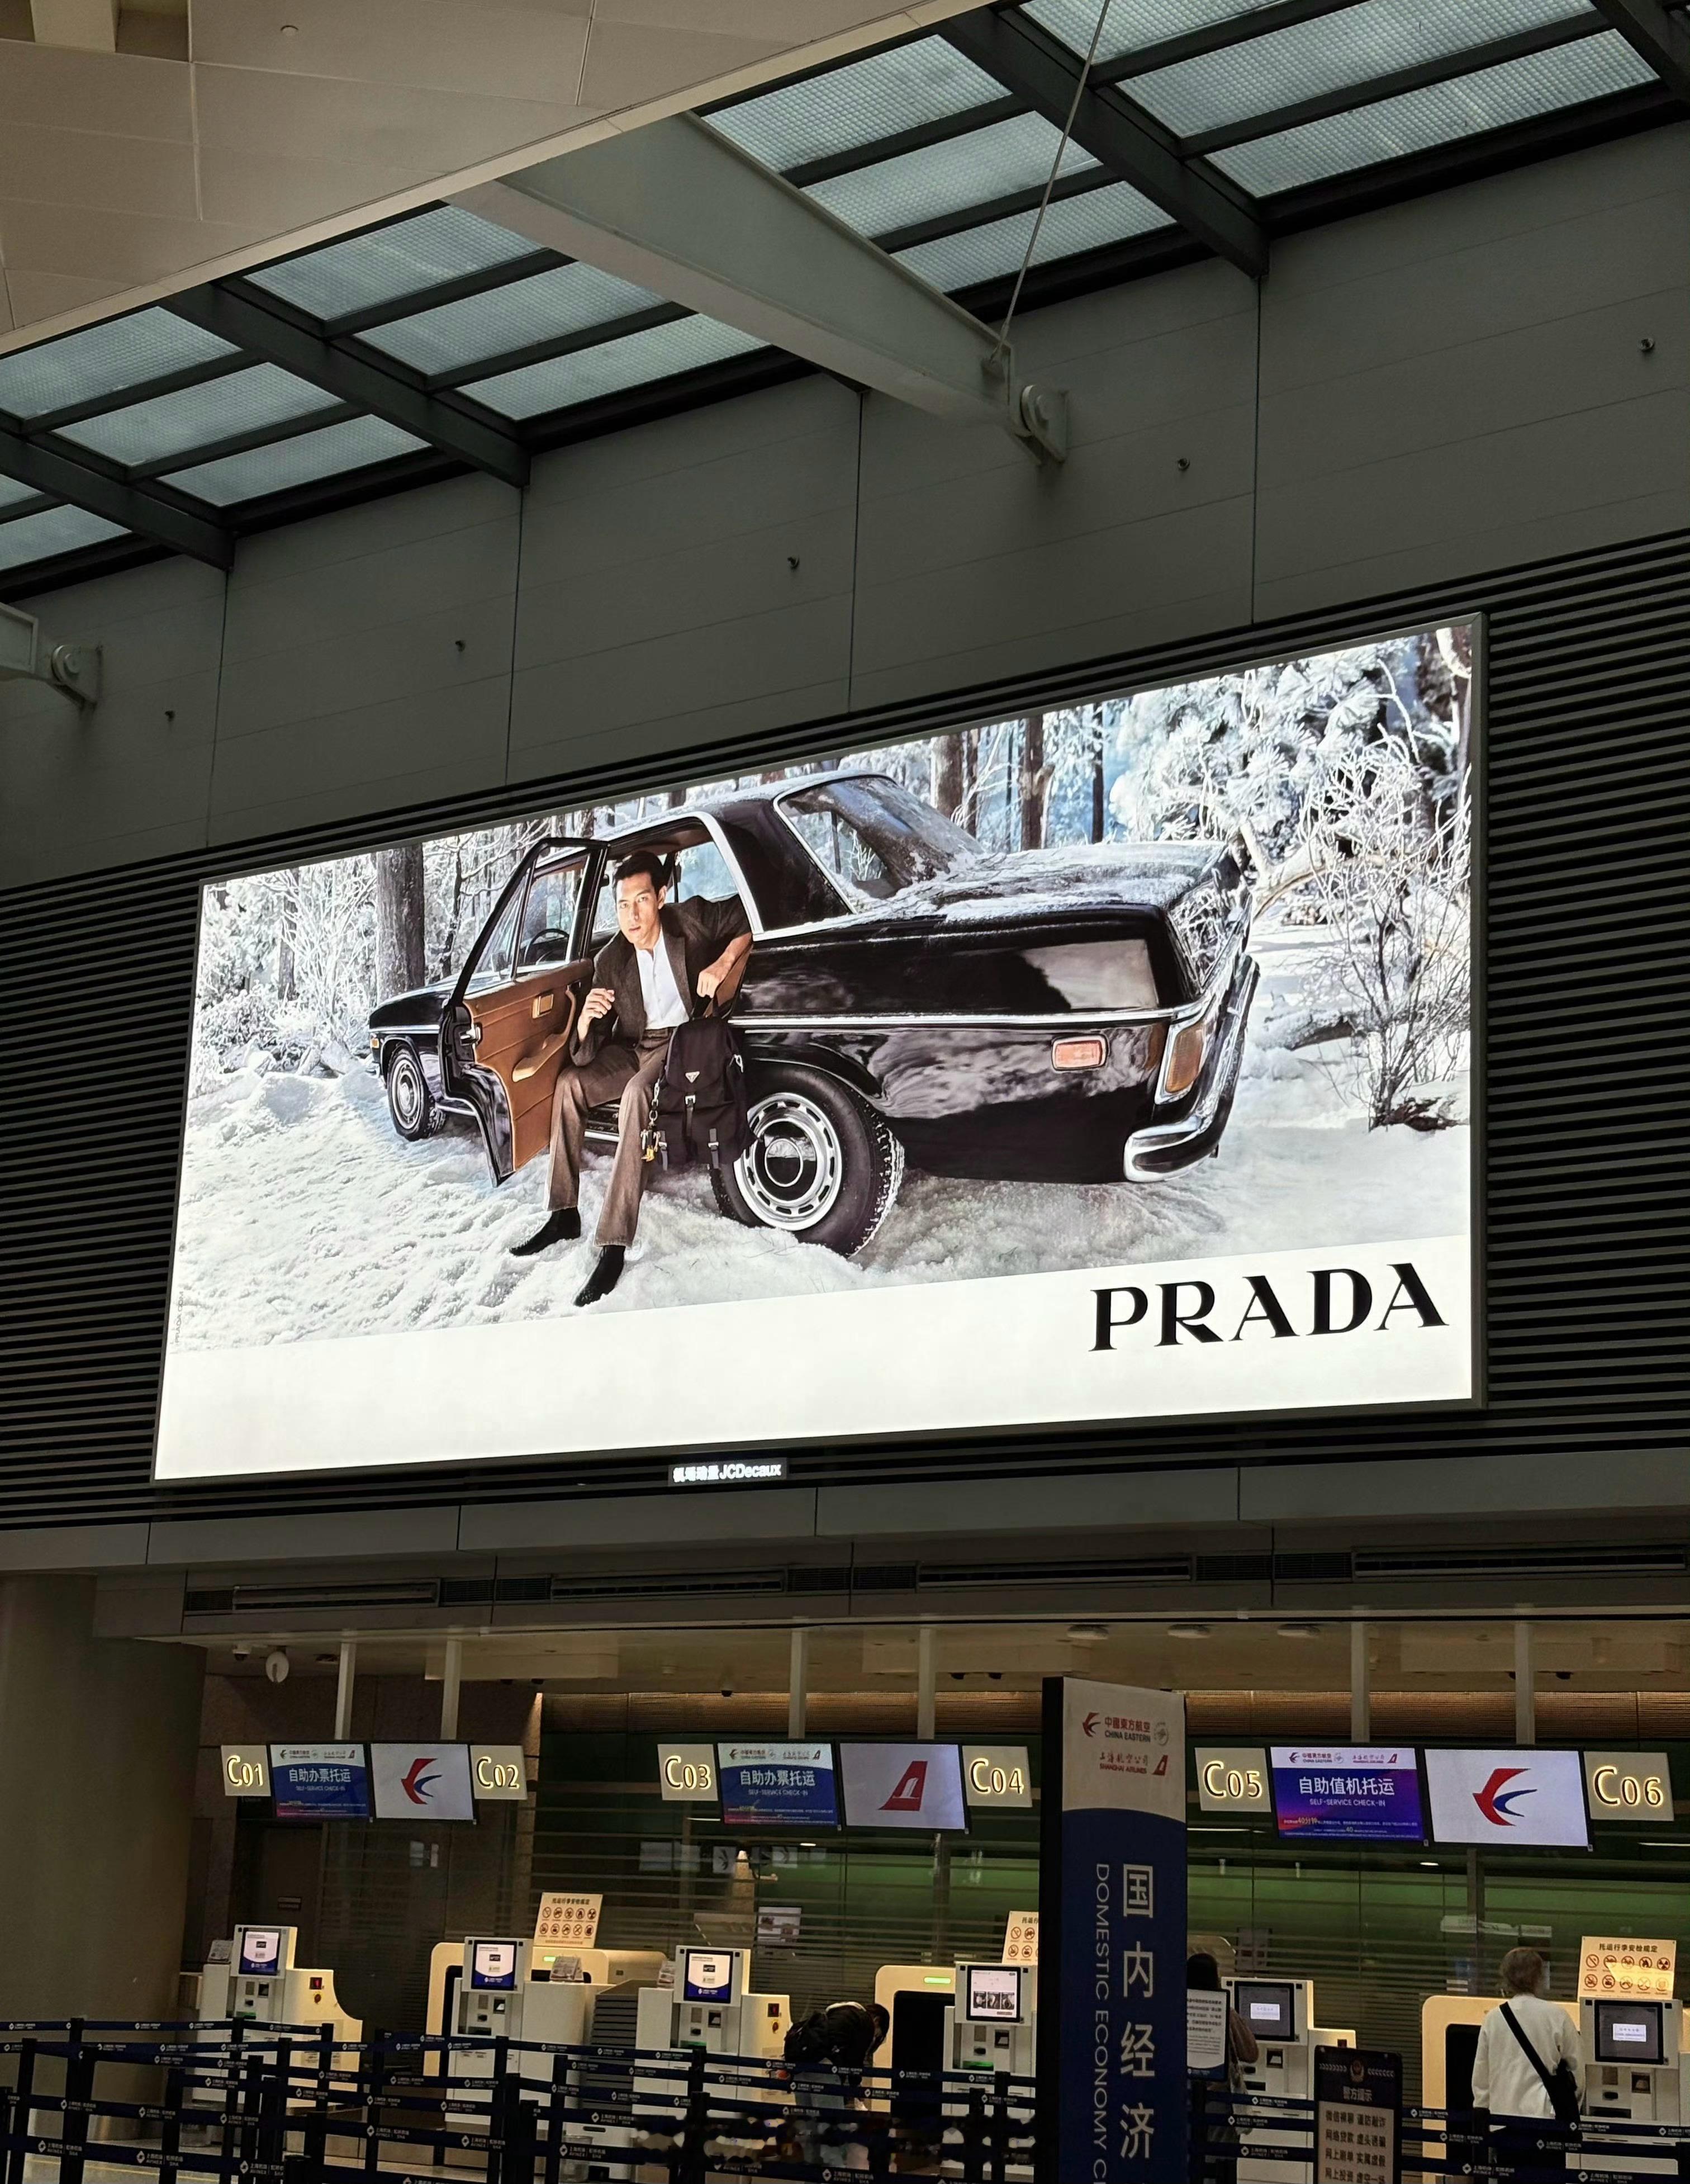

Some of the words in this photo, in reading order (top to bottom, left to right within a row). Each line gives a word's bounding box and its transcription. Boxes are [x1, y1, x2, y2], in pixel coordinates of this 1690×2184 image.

[1088, 1262, 1450, 1352] PRADA
[719, 1463, 781, 1480] JCDecaux
[1105, 1730, 1123, 1740] CHINA
[1124, 1732, 1151, 1743] EASTERN
[226, 1755, 264, 1787] C01
[289, 1768, 352, 1783] 自助办票托运
[476, 1756, 520, 1789] C02
[664, 1755, 711, 1790] C03
[740, 1769, 816, 1787] 自助办票托运
[969, 1757, 1024, 1794] C04
[1202, 1760, 1262, 1798] C05
[1299, 1776, 1395, 1795] 自助值机托运
[1592, 1766, 1664, 1807] C06
[1309, 1798, 1352, 1806] SELF-SERVICE
[1353, 1799, 1386, 1807] CHECK-IN
[1095, 1864, 1109, 2000] DOMESTIC
[1120, 1864, 1155, 2159] 国内经济
[1094, 2010, 1109, 2150] ECONOMY
